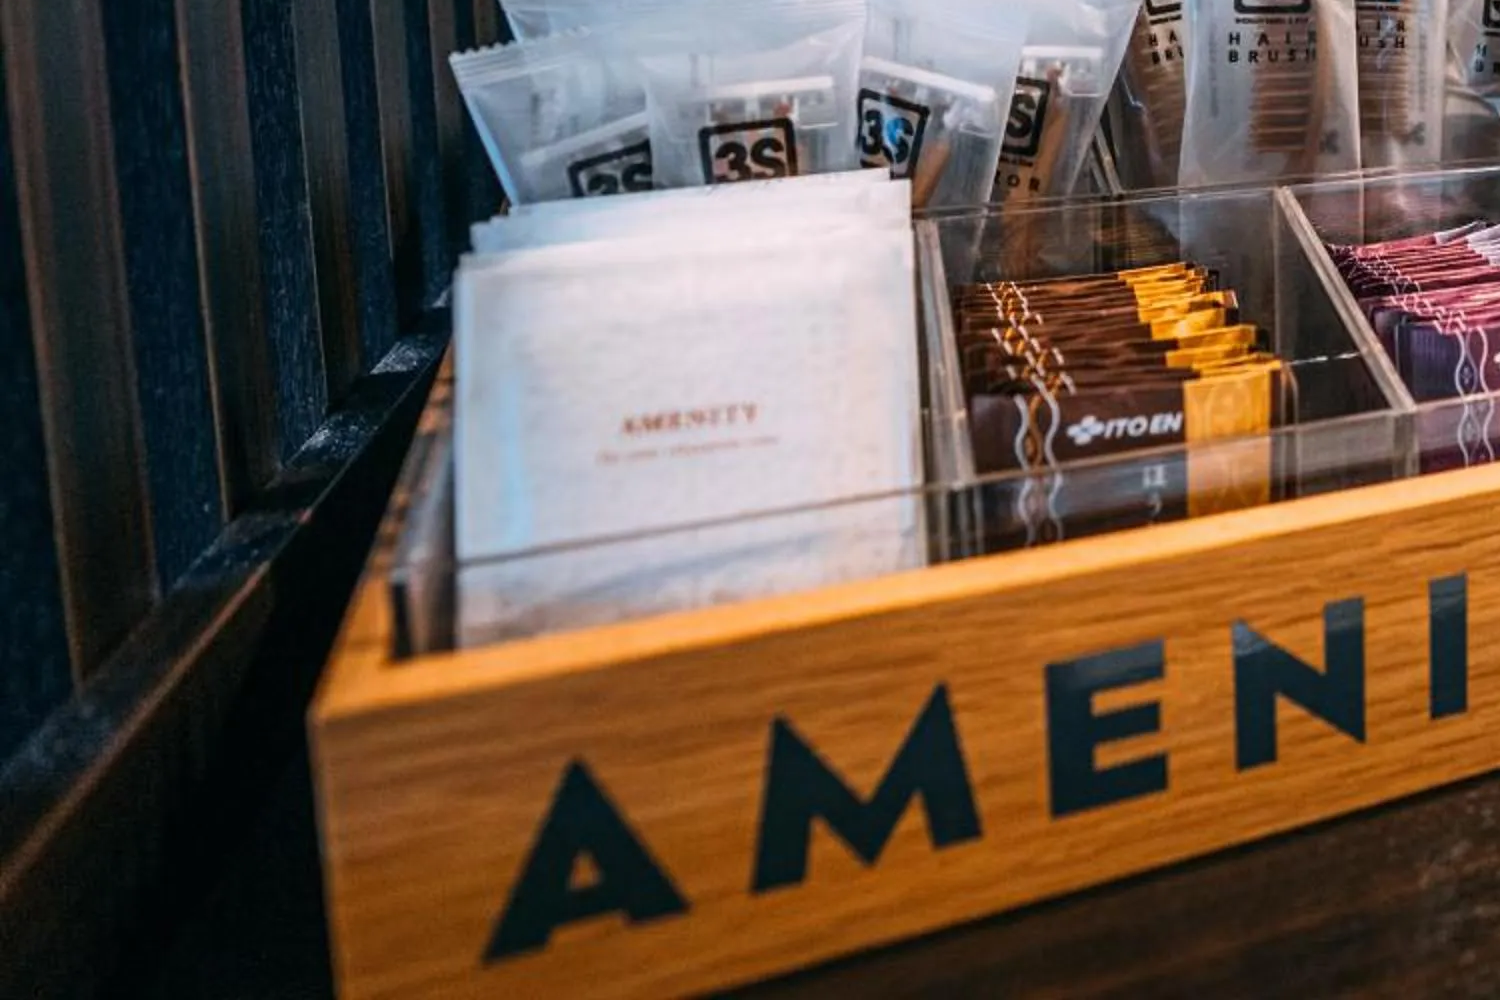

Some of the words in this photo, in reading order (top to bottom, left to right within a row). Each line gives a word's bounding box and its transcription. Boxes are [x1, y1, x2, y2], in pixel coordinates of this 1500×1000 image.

[1228, 31, 1317, 46] HAIR
[1228, 49, 1317, 63] BRUSH
[860, 110, 914, 163] 3S
[714, 136, 785, 183] 3S
[620, 401, 758, 435] AMENITY
[1105, 415, 1146, 438] ITO
[1148, 412, 1183, 433] EN
